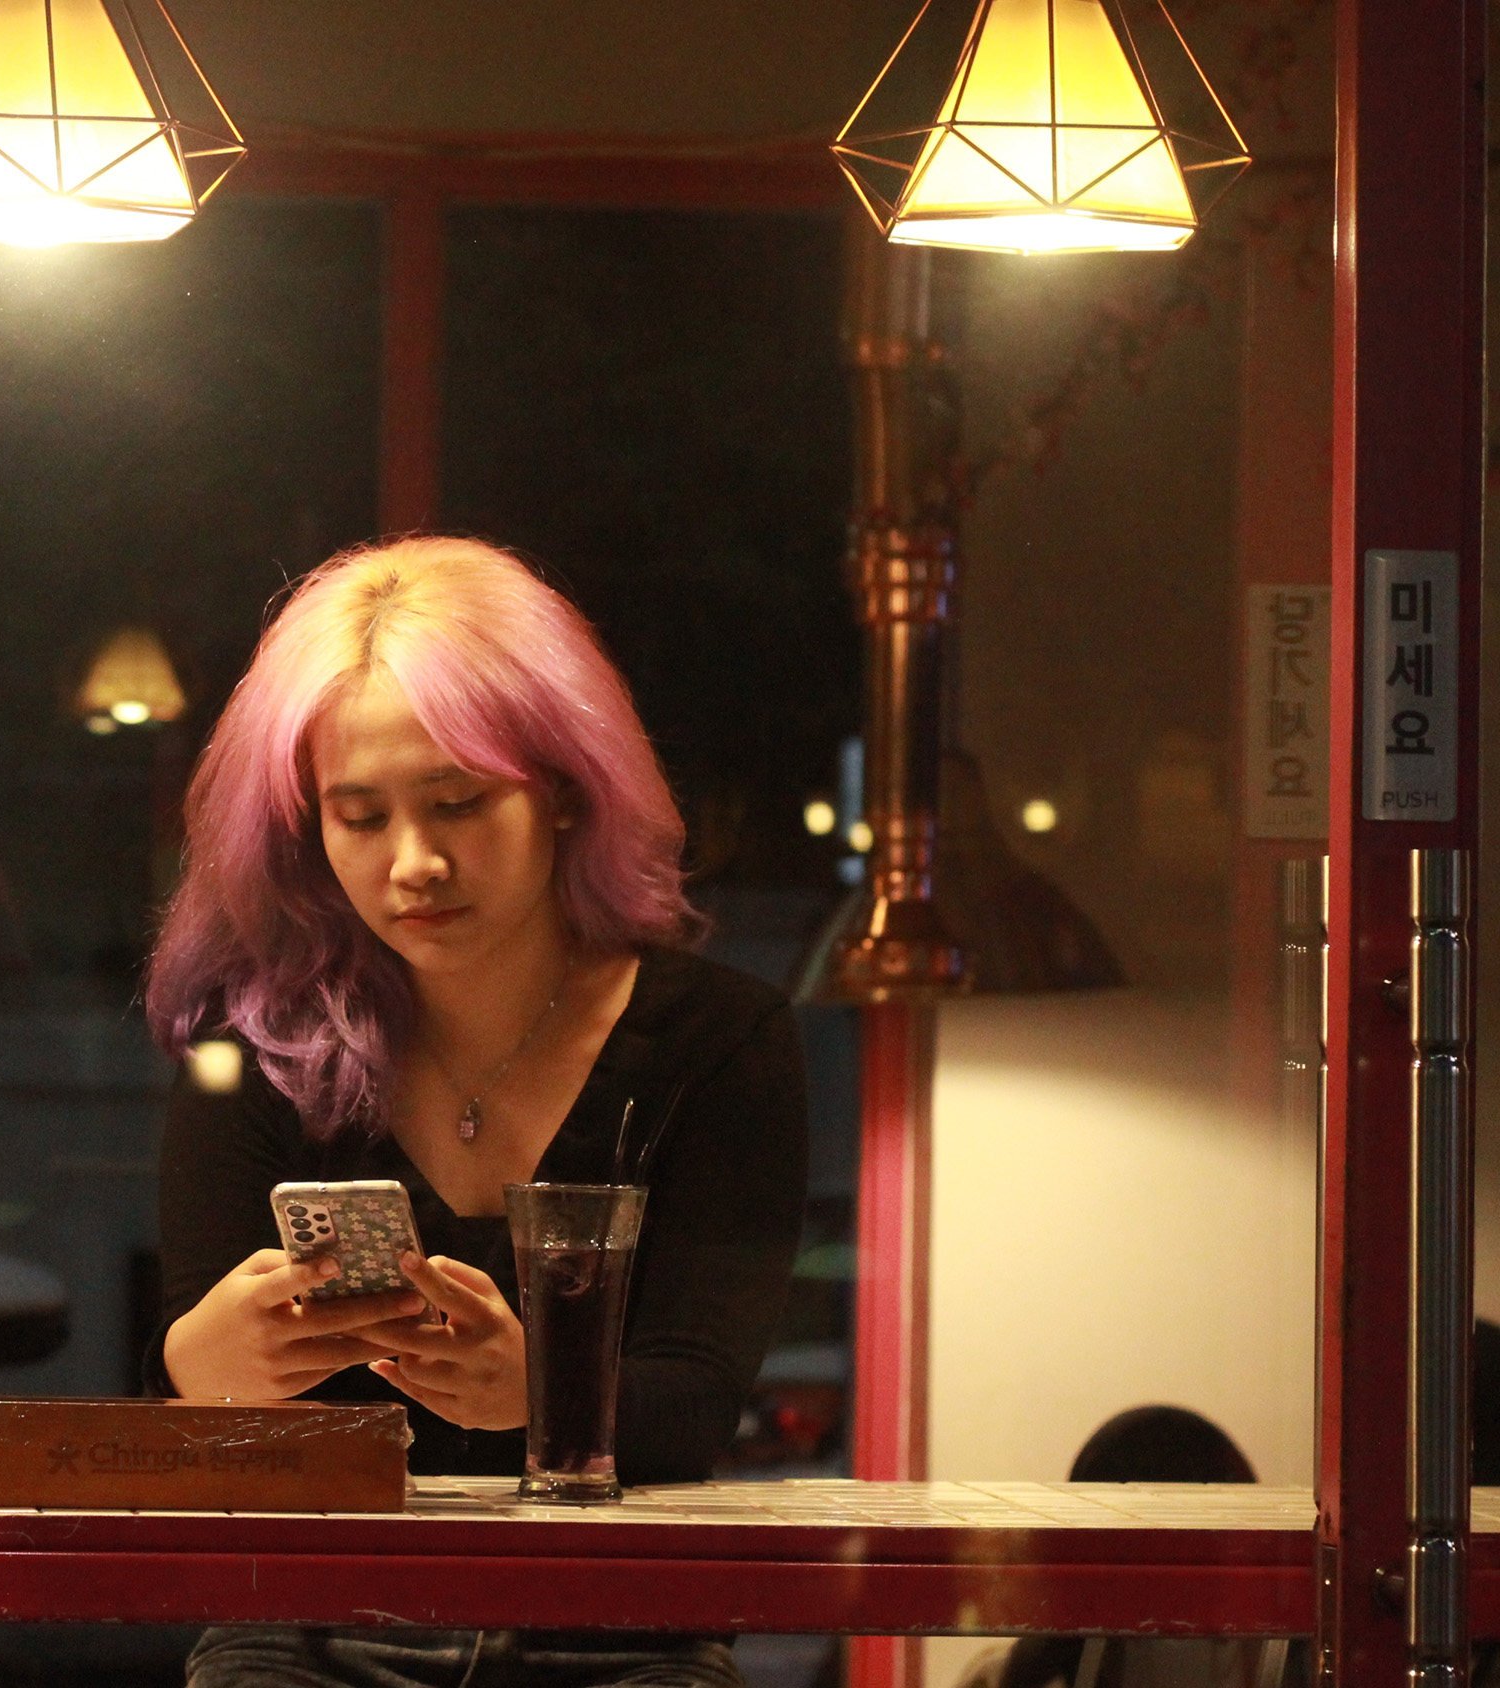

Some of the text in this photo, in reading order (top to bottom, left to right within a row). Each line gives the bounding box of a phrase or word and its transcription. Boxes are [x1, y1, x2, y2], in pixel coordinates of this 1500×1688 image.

[1385, 580, 1435, 756] 미세요
[1382, 791, 1439, 808] PUSH
[88, 1442, 200, 1473] Chingu
